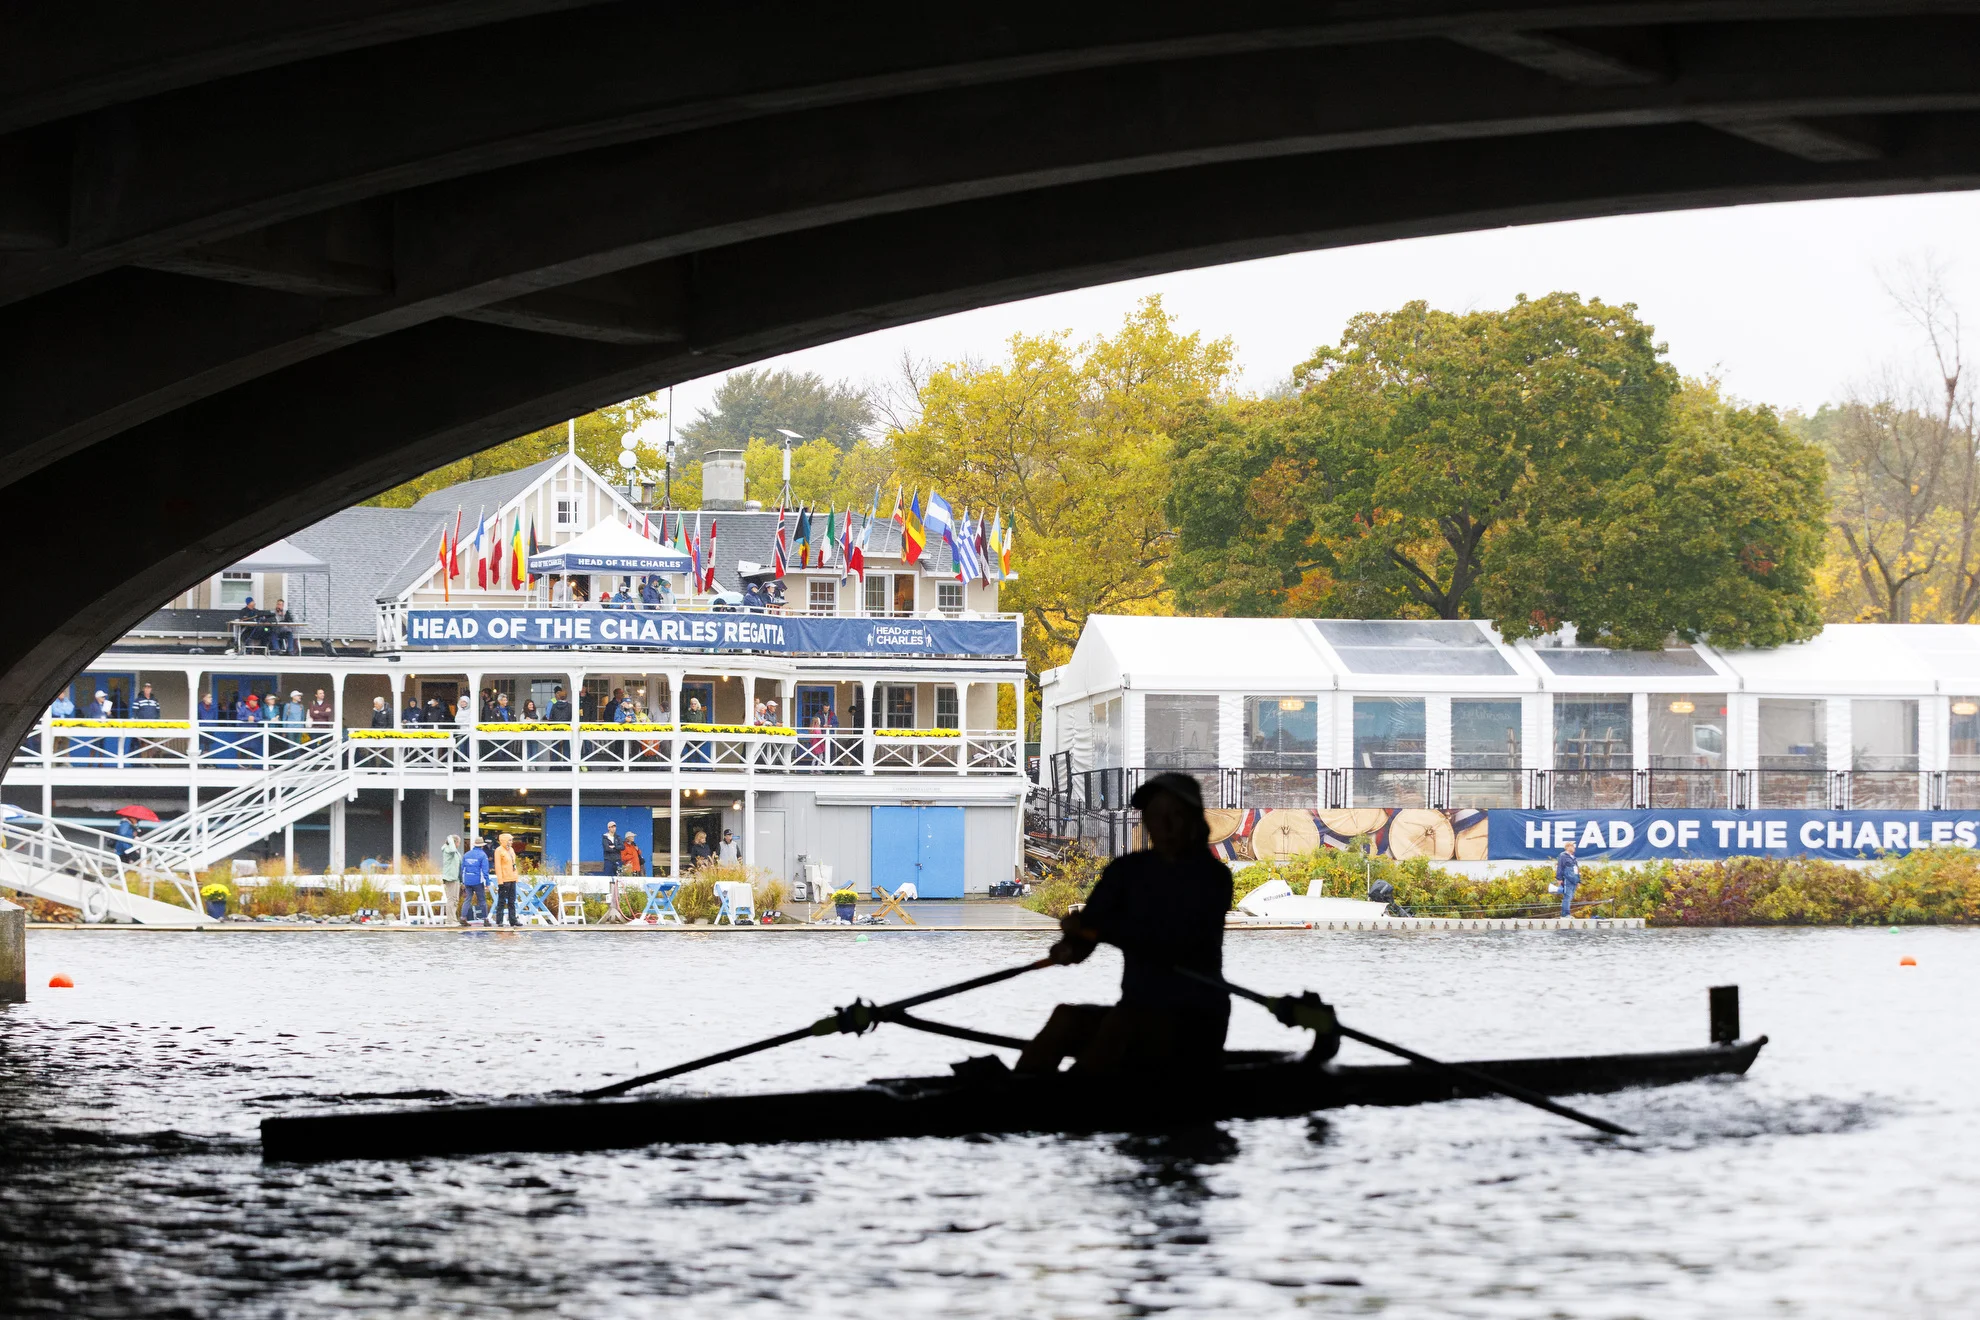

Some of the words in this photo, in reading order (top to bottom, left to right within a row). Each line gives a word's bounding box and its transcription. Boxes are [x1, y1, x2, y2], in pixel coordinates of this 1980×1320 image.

[578, 558, 603, 566] HEAD
[605, 559, 618, 567] OF
[412, 618, 479, 639] HEAD
[487, 617, 527, 639] OF
[535, 618, 592, 639] THE
[724, 621, 786, 645] REGATTA
[876, 626, 902, 635] HEAD
[876, 635, 924, 645] CHARLES
[1525, 820, 1635, 849] HEAD
[1647, 819, 1701, 849] OF
[1711, 820, 1788, 849] THE
